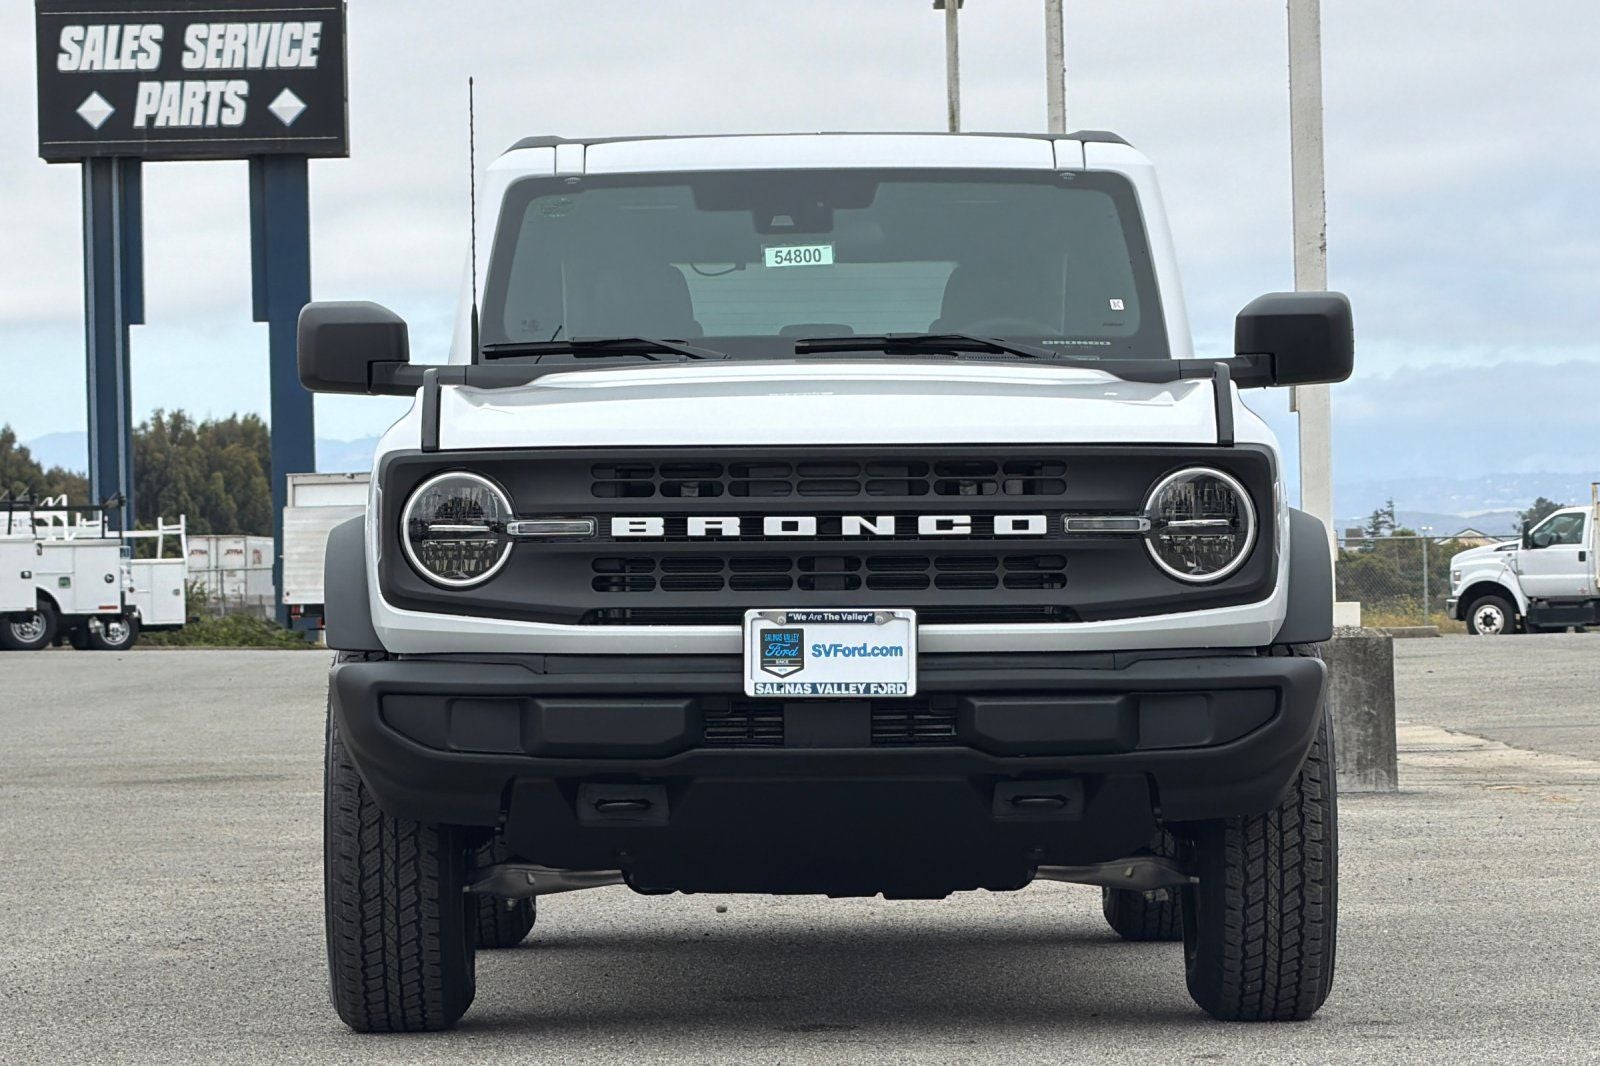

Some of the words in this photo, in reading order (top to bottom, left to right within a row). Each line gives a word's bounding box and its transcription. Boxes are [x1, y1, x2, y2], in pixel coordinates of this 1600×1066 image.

[57, 24, 164, 72] SALES
[182, 21, 323, 70] SERVICE
[133, 80, 249, 128] PARTS
[774, 248, 822, 264] 54800
[611, 515, 1047, 537] BRONCO
[808, 612, 822, 621] Are
[823, 612, 840, 621] The
[765, 642, 799, 657] Ford
[811, 642, 904, 658] SVFord.com
[755, 682, 813, 694] SALINAS
[816, 682, 867, 694] VALLEY
[869, 682, 906, 694] FORD
